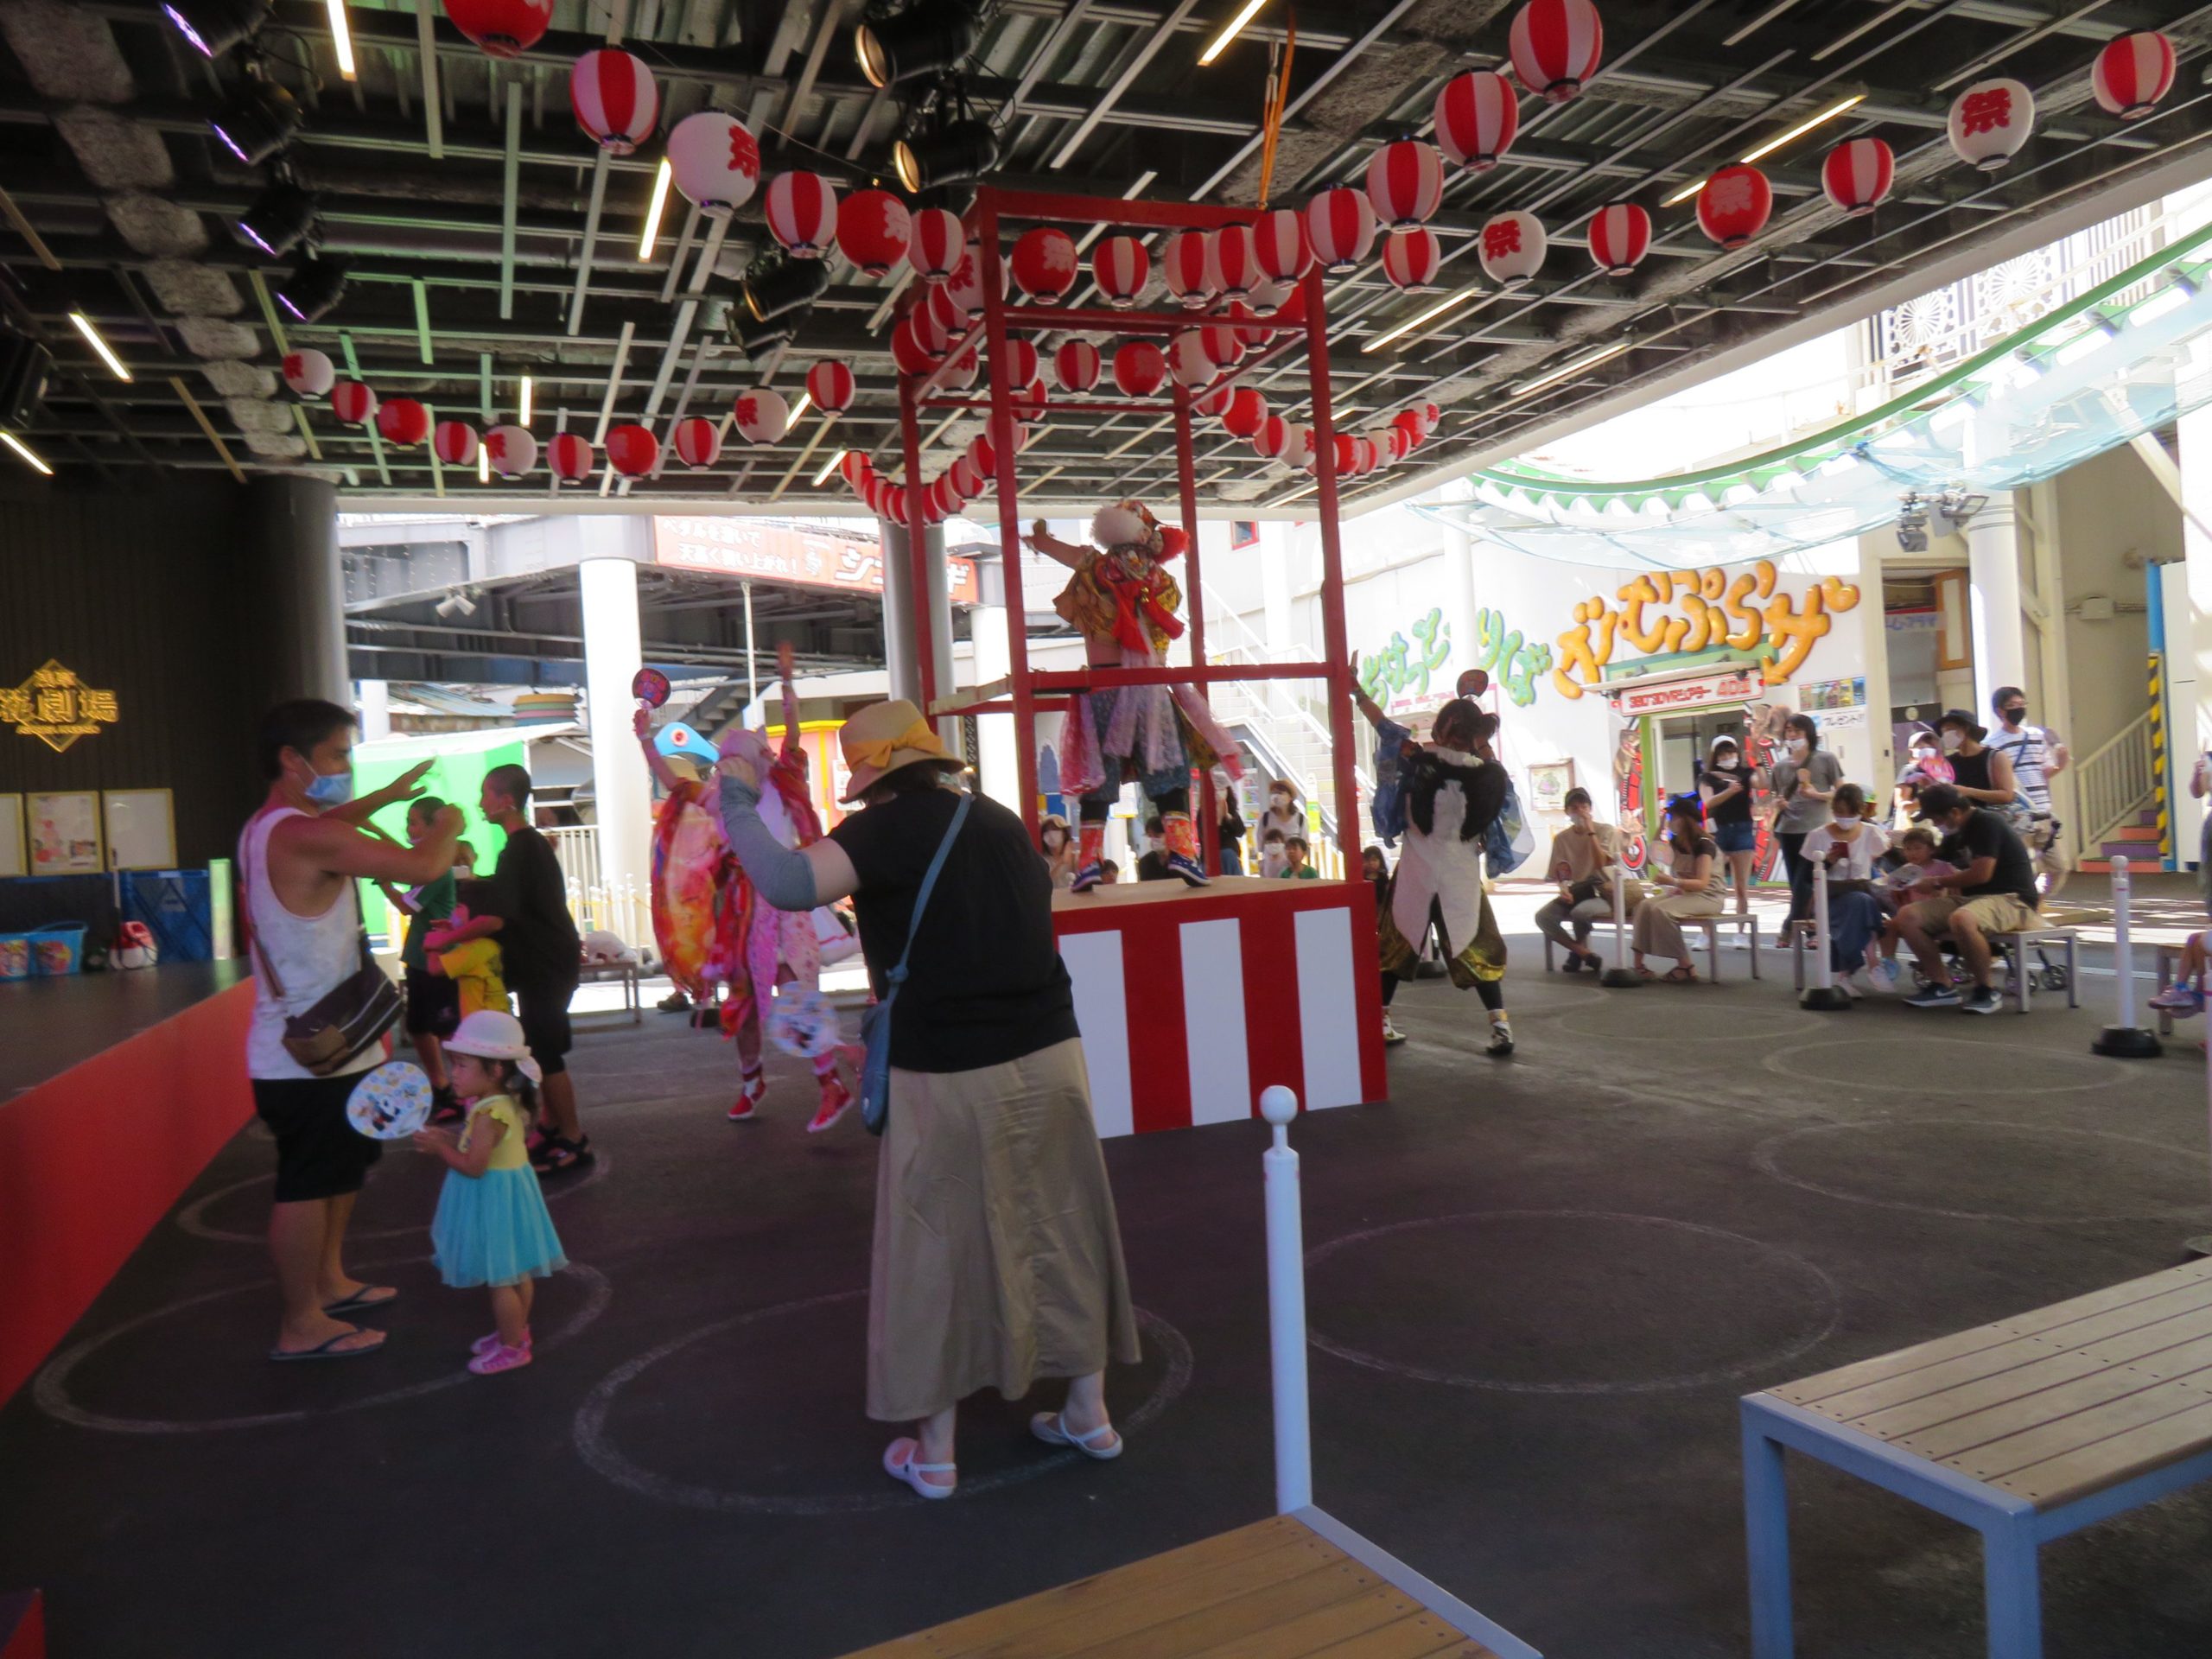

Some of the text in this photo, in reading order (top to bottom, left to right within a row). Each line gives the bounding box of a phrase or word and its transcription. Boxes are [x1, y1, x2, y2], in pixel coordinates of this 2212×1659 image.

[1961, 86, 2012, 137] 祭
[1708, 173, 1754, 219] 祭
[1484, 219, 1522, 262] 祭
